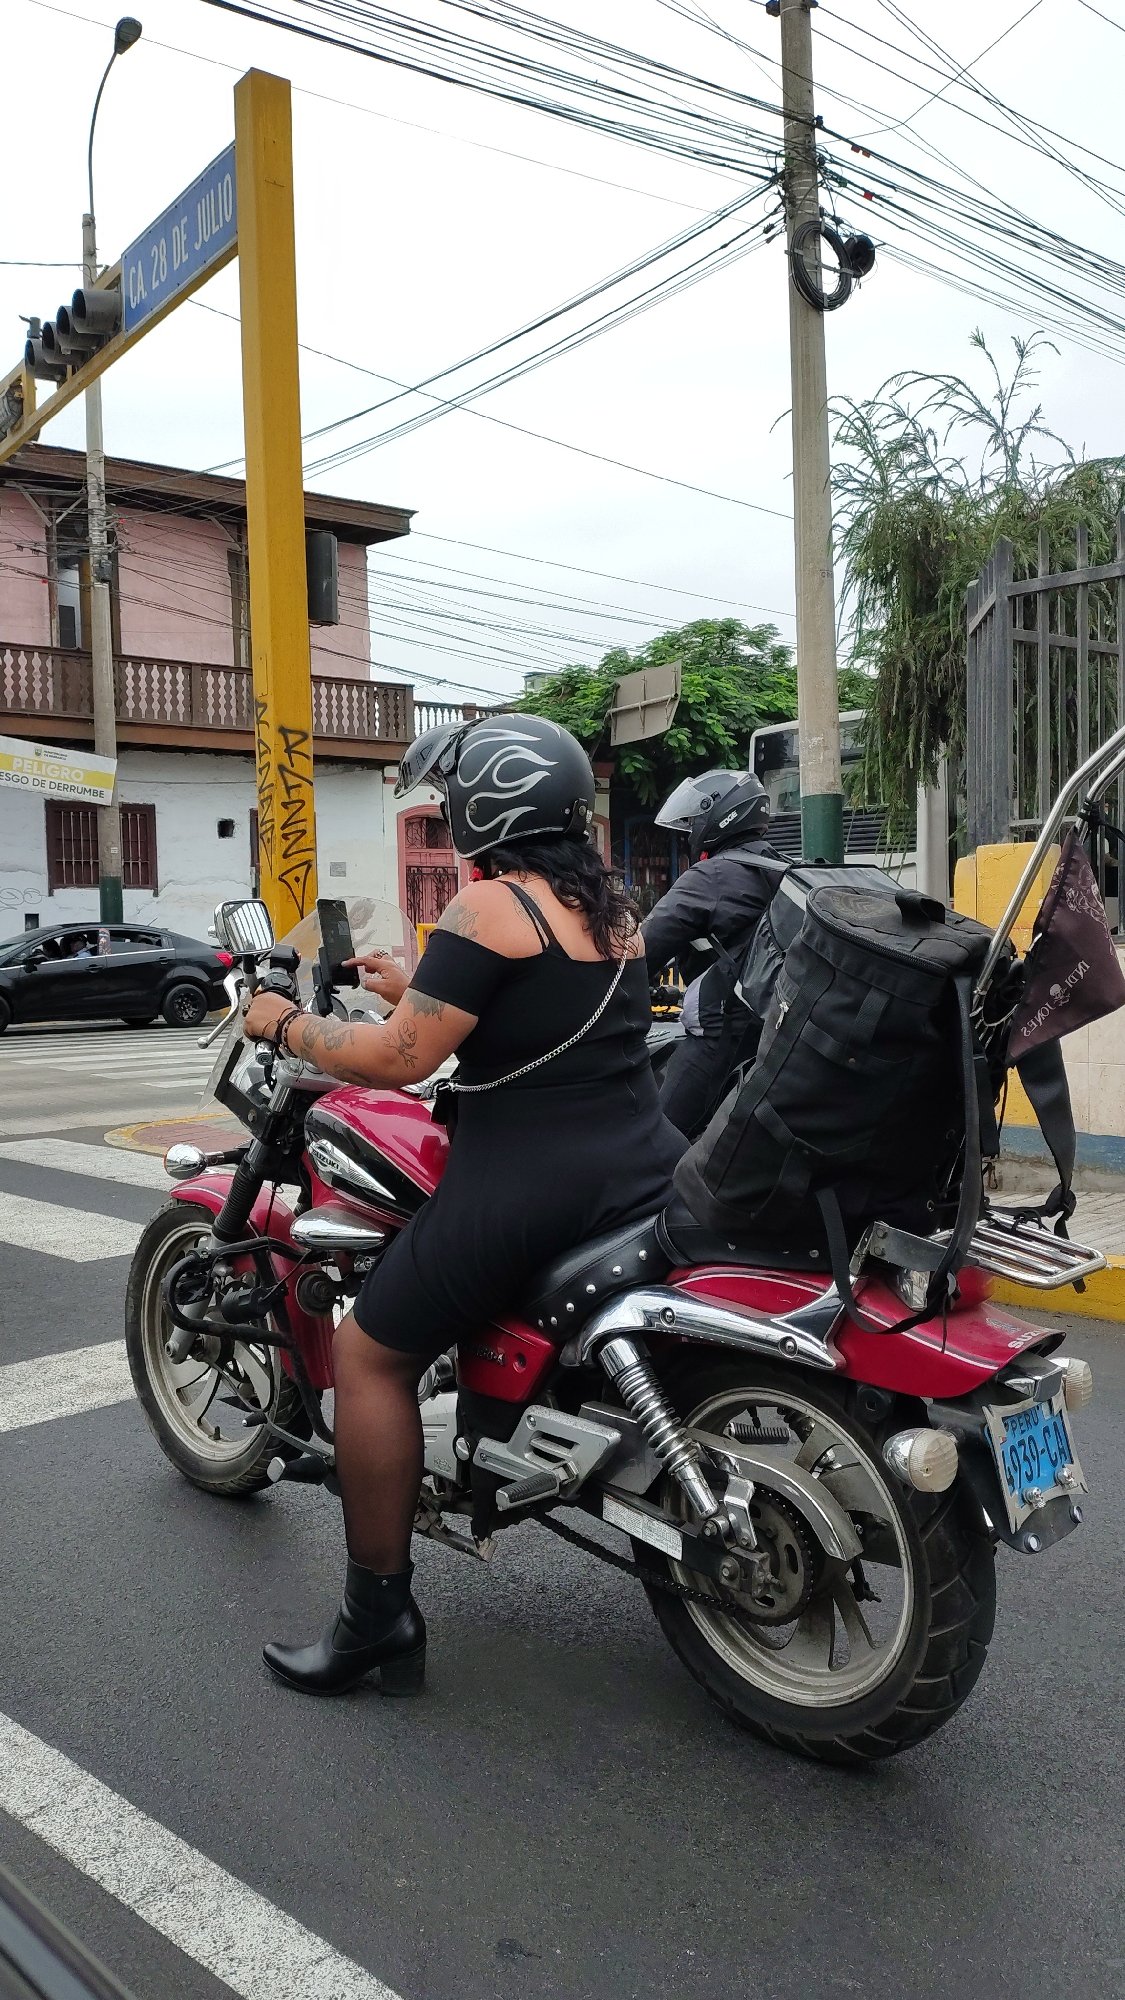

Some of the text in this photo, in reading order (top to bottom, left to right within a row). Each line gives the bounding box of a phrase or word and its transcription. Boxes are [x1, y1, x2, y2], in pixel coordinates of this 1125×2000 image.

[129, 173, 232, 309] CA. 28 DE JULIO
[12, 758, 84, 781] PELIGRO
[32, 778, 46, 788] DE
[49, 780, 105, 798] DERRUMBE
[719, 810, 738, 828] EDGE
[312, 1149, 340, 1170] SUZUKI
[1010, 1406, 1039, 1438] PERU
